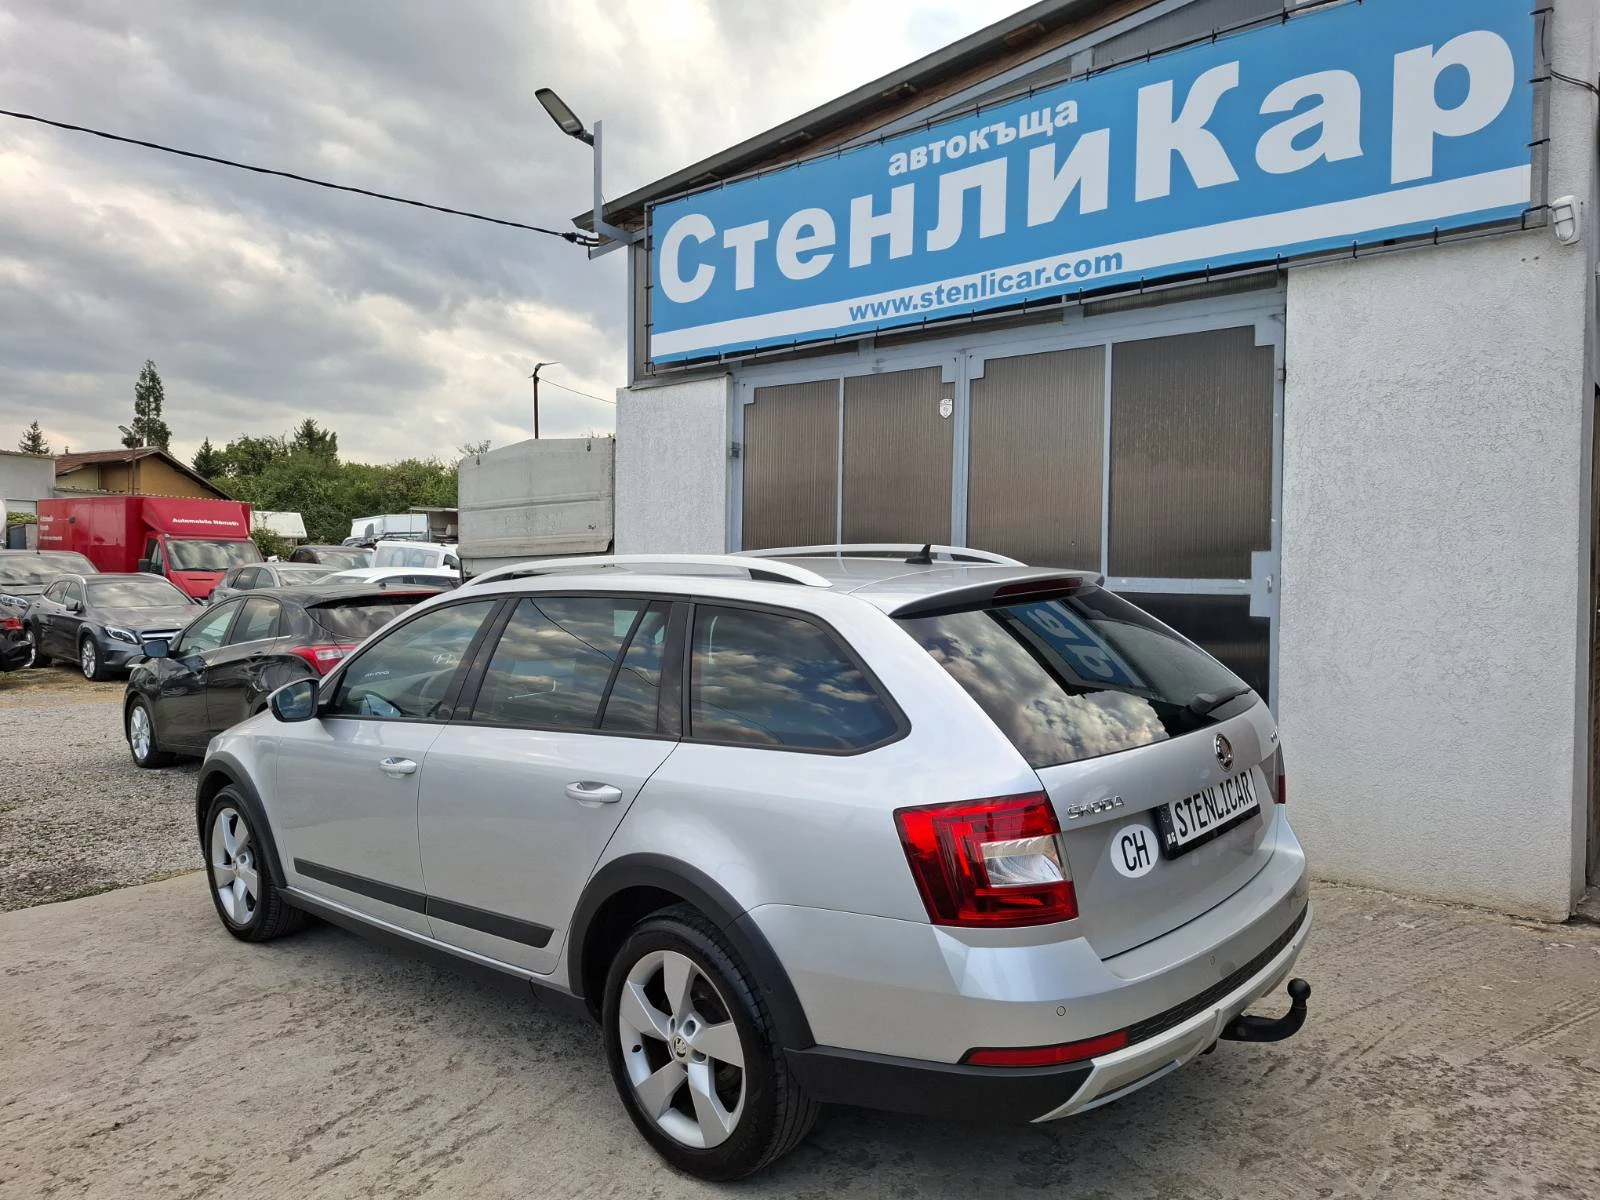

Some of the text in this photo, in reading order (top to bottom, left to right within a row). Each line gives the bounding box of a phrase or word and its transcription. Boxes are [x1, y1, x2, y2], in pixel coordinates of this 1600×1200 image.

[888, 99, 1078, 176] автокъща
[849, 251, 1123, 323] www.stenlicar.com
[1174, 770, 1253, 838] STENLICAR
[1121, 830, 1151, 871] CH
